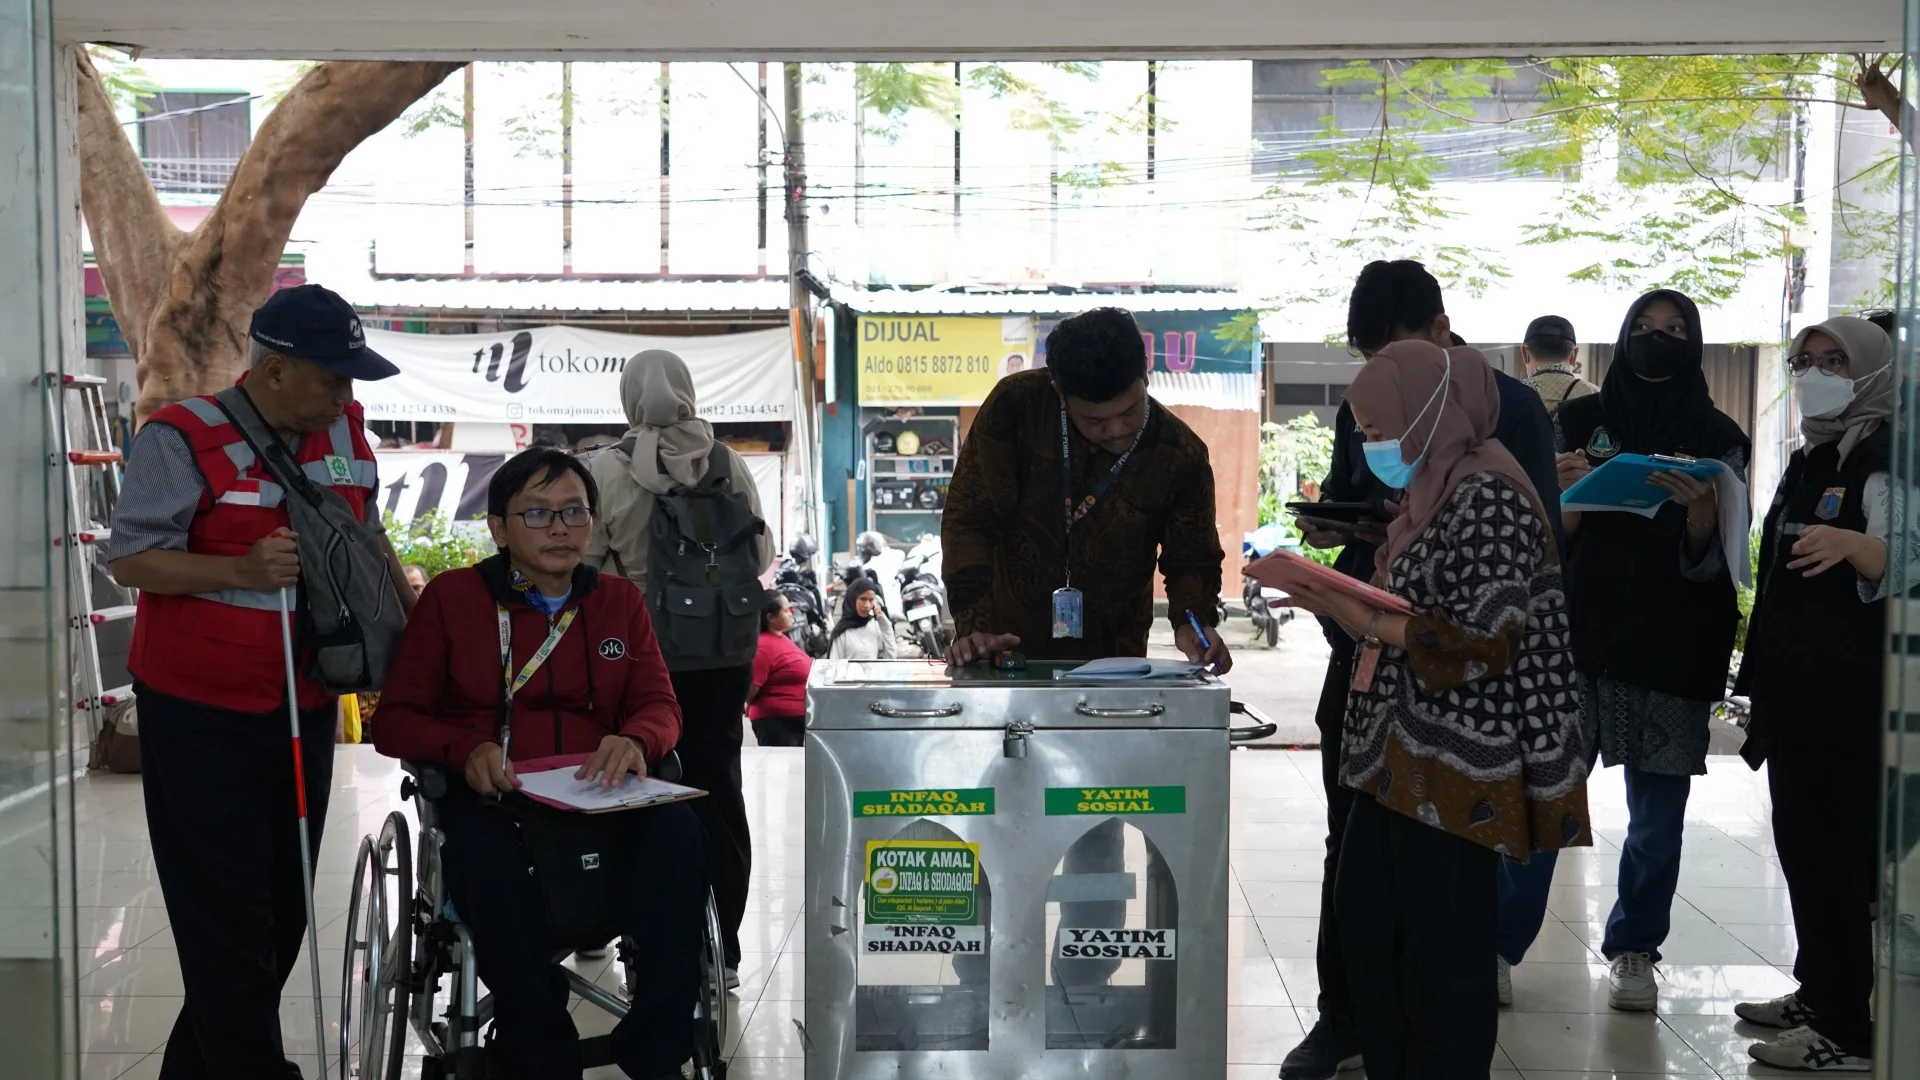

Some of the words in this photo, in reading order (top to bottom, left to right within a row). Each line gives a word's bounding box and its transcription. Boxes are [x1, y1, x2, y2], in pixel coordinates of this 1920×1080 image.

[863, 321, 940, 342] DIJUAL
[864, 355, 893, 373] Aldo
[897, 355, 928, 373] 0815
[932, 355, 962, 373] 8872
[967, 355, 990, 373] 810
[371, 404, 397, 414] 0812
[730, 404, 755, 415] 1234
[758, 404, 785, 415] 4347
[890, 791, 958, 803] INFAQ
[1081, 789, 1149, 800] YATIM
[862, 802, 986, 815] SHADAQAH
[1076, 801, 1155, 812] SOSIAL
[876, 850, 926, 867] KOTAK
[930, 851, 971, 868] AMAL
[899, 872, 922, 891] INFAQ
[923, 873, 930, 890] &
[931, 872, 973, 891] SHODAQOH
[893, 926, 956, 939] INFAQ
[1068, 929, 1166, 943] YATIM
[868, 940, 981, 954] SHADAQAH
[1062, 944, 1173, 958] SOSIAL
